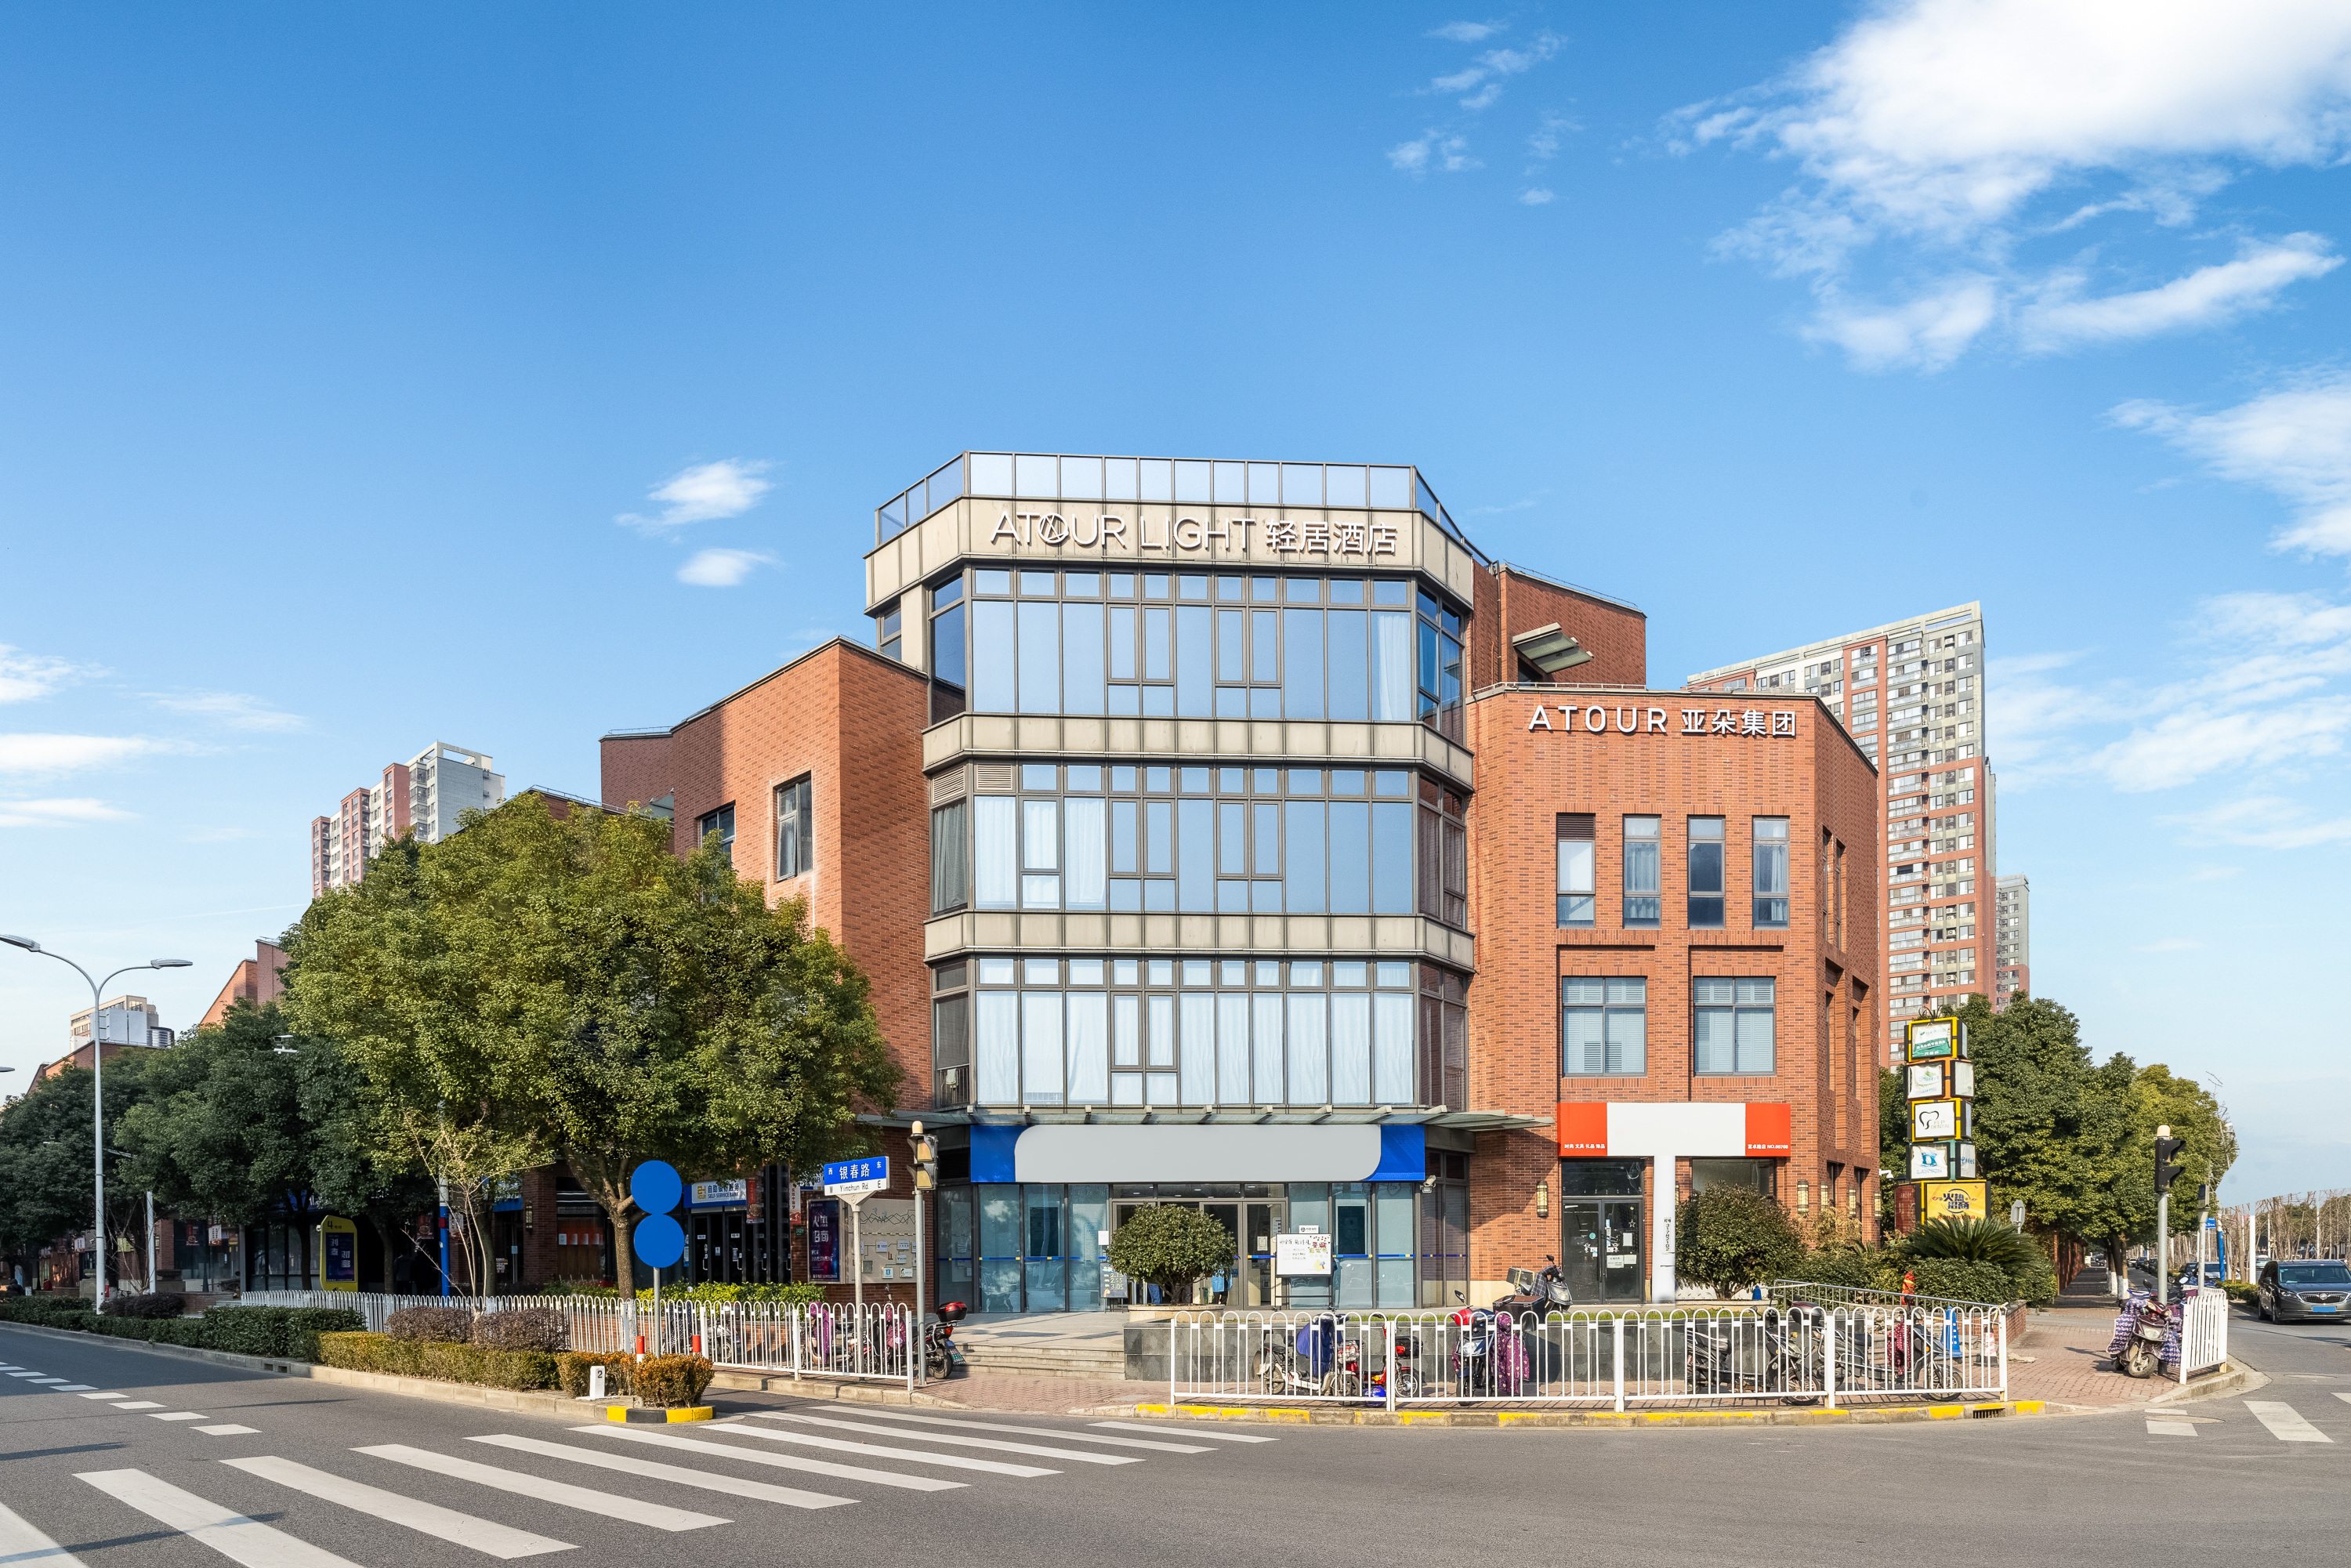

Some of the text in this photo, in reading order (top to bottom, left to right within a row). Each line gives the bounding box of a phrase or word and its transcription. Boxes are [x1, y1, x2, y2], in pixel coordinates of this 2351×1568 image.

[990, 510, 1398, 555] ATOUR LIGHT 轻居酒店
[1528, 704, 1796, 737] ATOUR 亚朵集团
[839, 1162, 870, 1180] 银春路
[839, 1183, 860, 1193] Yinchun
[597, 1370, 603, 1378] 2
